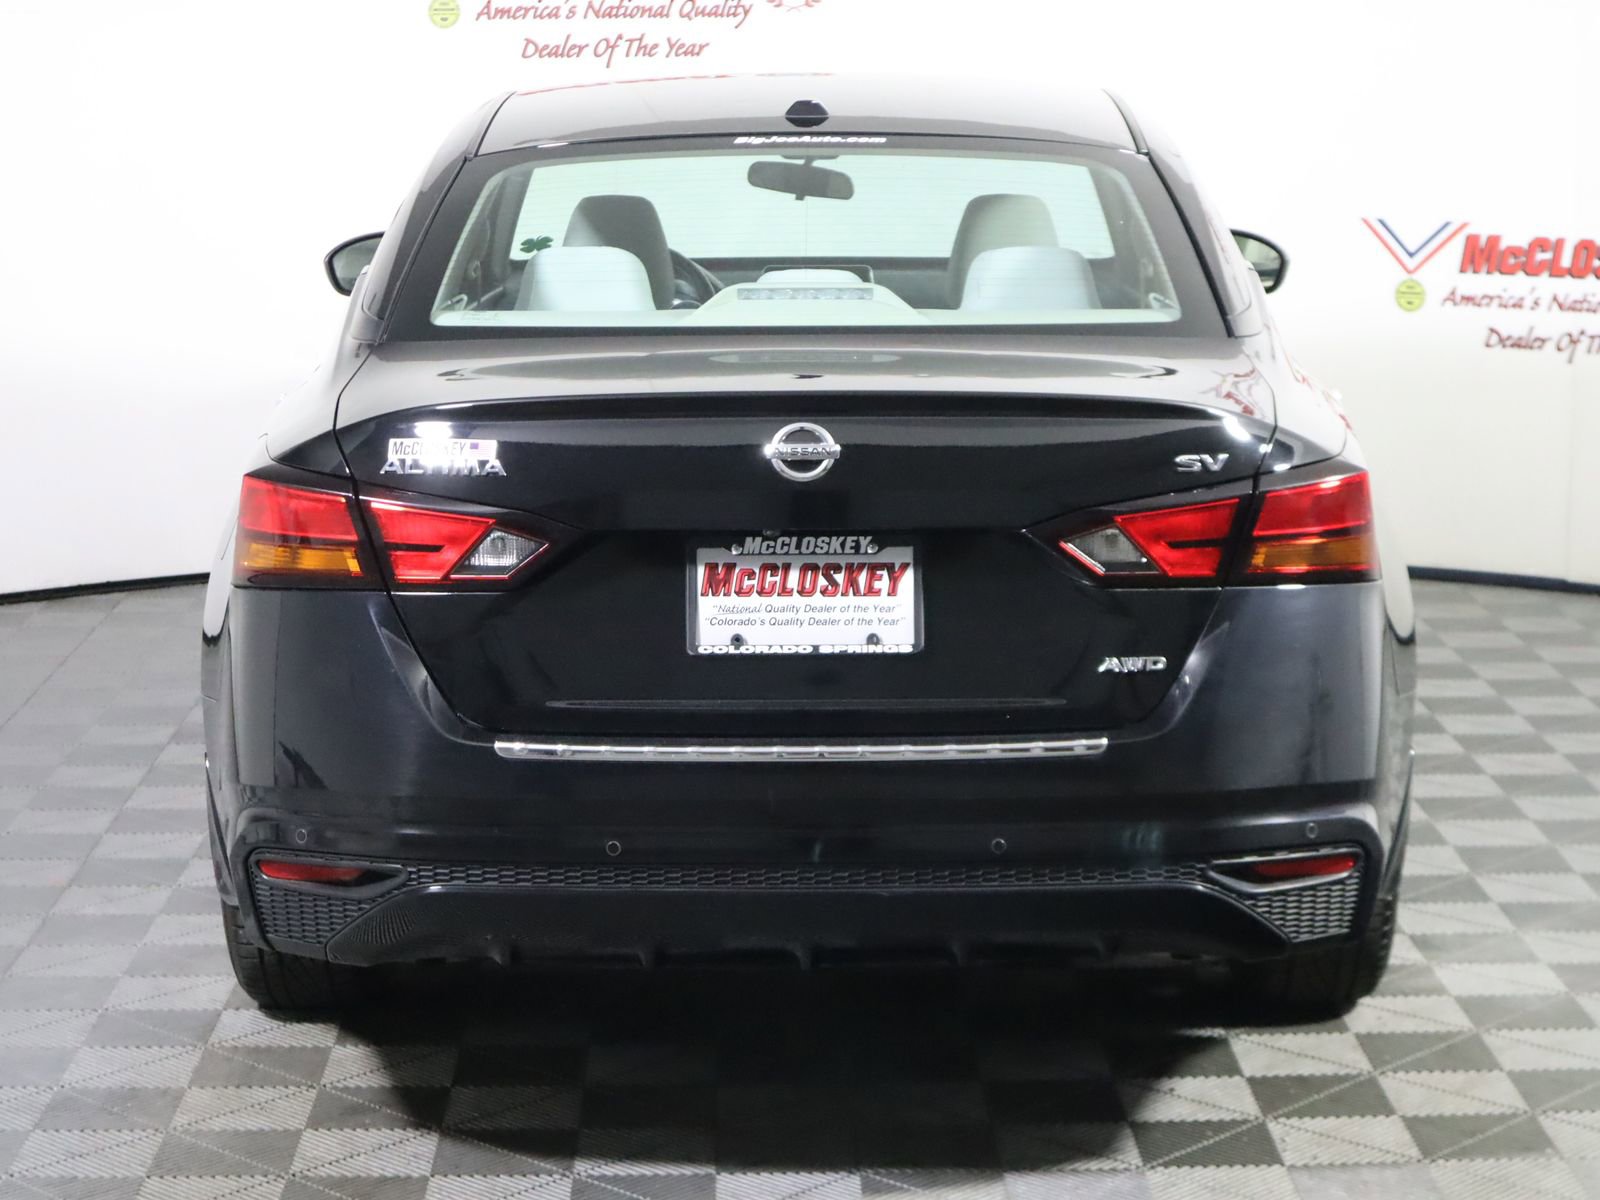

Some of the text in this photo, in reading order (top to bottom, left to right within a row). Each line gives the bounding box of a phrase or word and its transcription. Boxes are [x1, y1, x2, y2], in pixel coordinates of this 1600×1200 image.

[476, 0, 577, 21] America's
[584, 0, 672, 20] National
[679, 0, 753, 28] Quality
[521, 33, 710, 69] Dealer Of The Year
[1441, 286, 1542, 311] America's
[1547, 292, 1600, 314] Nati
[1485, 325, 1552, 351] Dealer
[1556, 329, 1586, 364] Of
[774, 447, 832, 456] NISSAN
[1174, 453, 1230, 471] SV
[741, 536, 873, 555] McCLOSKEY
[700, 562, 912, 597] McCLOSKEY
[764, 603, 802, 616] Quality
[803, 604, 837, 614] Dealer
[839, 604, 851, 614] of
[853, 604, 870, 614] the
[768, 617, 806, 629] Quality
[808, 617, 842, 627] Dealer
[843, 617, 855, 627] of
[857, 617, 874, 627] the
[697, 643, 914, 654] COLORADO SPRINGS
[1097, 656, 1168, 672] AWD
